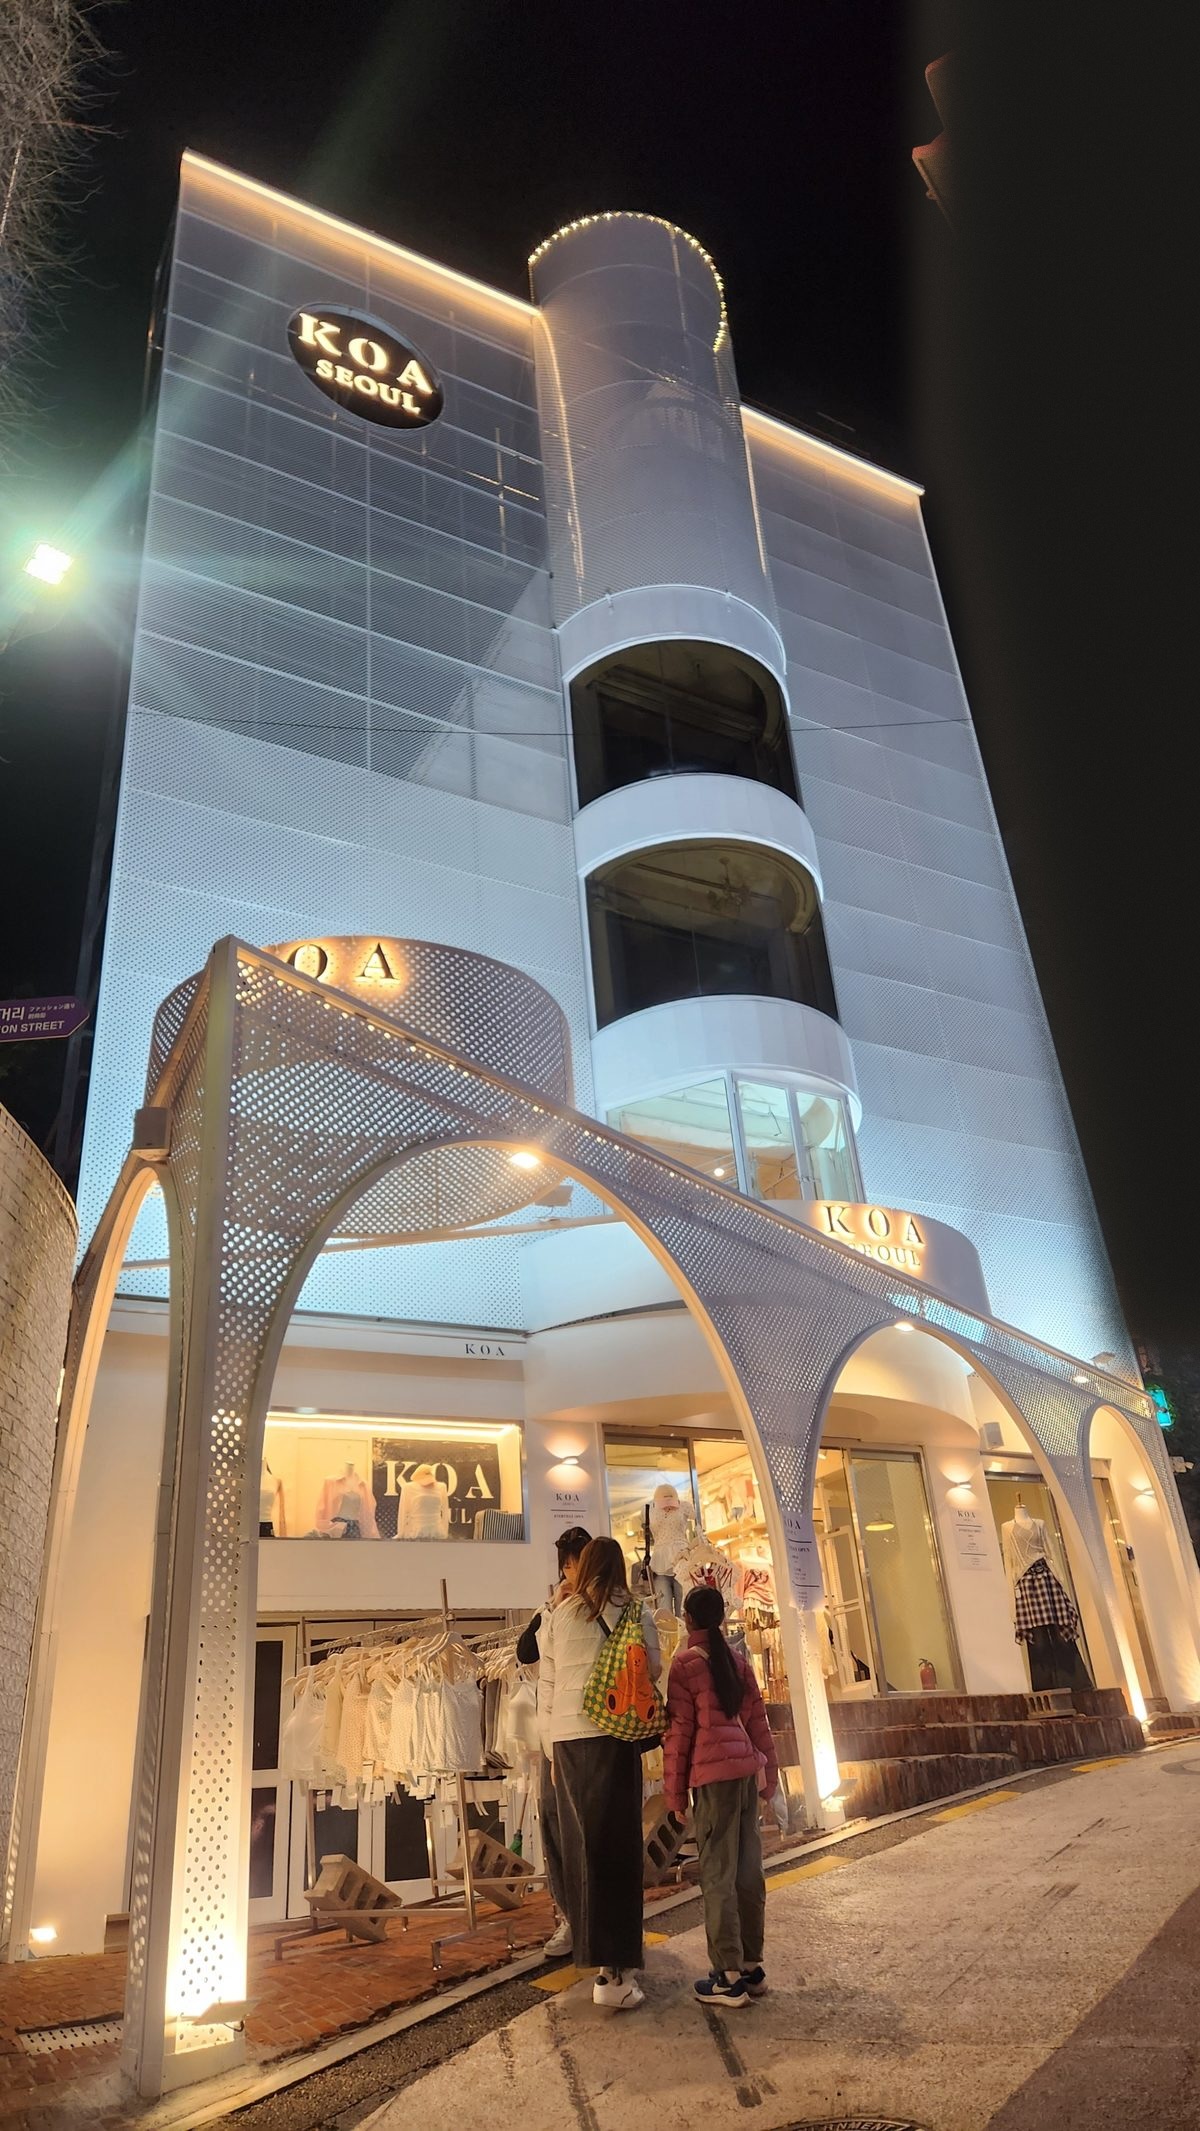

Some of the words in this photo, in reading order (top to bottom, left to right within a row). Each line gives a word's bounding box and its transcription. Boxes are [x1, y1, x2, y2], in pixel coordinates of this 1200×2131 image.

[298, 312, 433, 395] KOA
[316, 359, 422, 415] SEOUL
[20, 1020, 65, 1033] STREET
[823, 1205, 925, 1245] KOA
[465, 1343, 505, 1356] KOA
[383, 1459, 494, 1500] KOA
[556, 1492, 580, 1502] KOA
